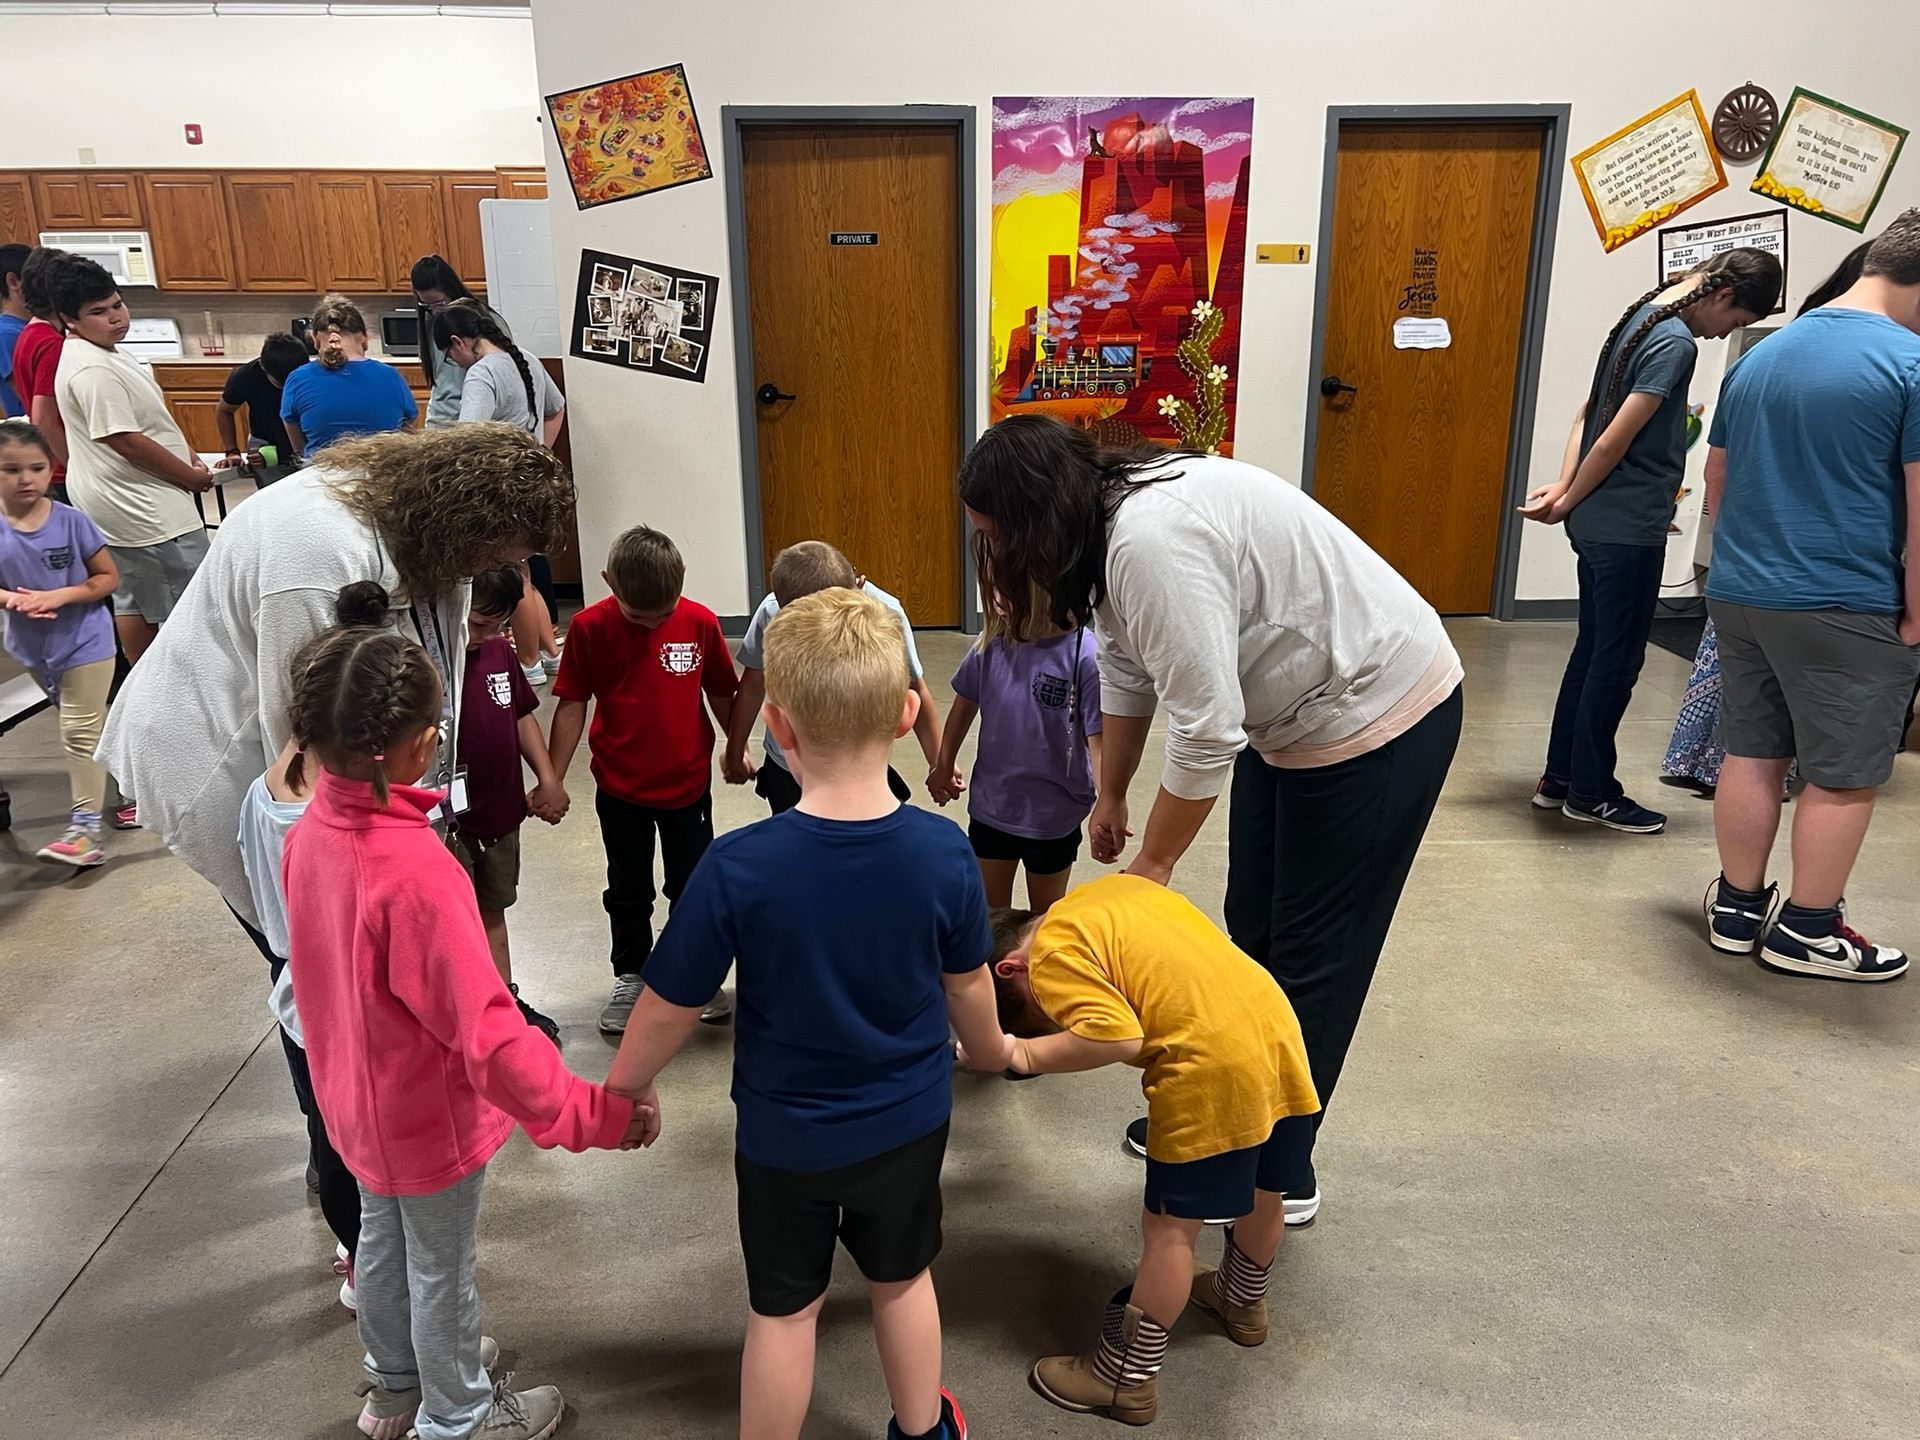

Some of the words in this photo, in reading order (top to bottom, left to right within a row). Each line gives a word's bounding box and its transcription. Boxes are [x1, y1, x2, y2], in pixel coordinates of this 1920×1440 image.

[1606, 161, 1616, 171] But
[1618, 152, 1633, 164] these
[1635, 146, 1645, 155] are
[1647, 133, 1669, 147] written
[1797, 124, 1813, 135] Your
[1814, 131, 1842, 148] kingdom
[1862, 152, 1879, 162] your
[1798, 141, 1810, 150] will
[1812, 146, 1820, 154] be
[1849, 160, 1868, 173] earth
[1598, 176, 1611, 186] that
[1613, 170, 1624, 180] you
[1626, 162, 1638, 174] may
[1639, 149, 1659, 163] believe
[1661, 142, 1674, 151] that
[1676, 130, 1692, 143] Jesus
[1615, 181, 1624, 189] the
[1647, 162, 1656, 171] the
[1658, 156, 1668, 166] Son
[1670, 149, 1676, 158] of
[1608, 195, 1618, 205] and
[1620, 187, 1632, 198] that
[1644, 168, 1671, 184] believing
[1672, 160, 1682, 170] you
[1684, 151, 1697, 162] may
[1624, 197, 1638, 207] have
[1640, 190, 1650, 199] life
[1660, 179, 1669, 187] his
[837, 235, 871, 243] PRIVATE
[1712, 242, 1734, 252] JESSE
[1752, 235, 1776, 244] BUTCH
[1673, 249, 1693, 258] BILLY
[1685, 257, 1699, 265] KID
[1399, 287, 1439, 310] Jesus
